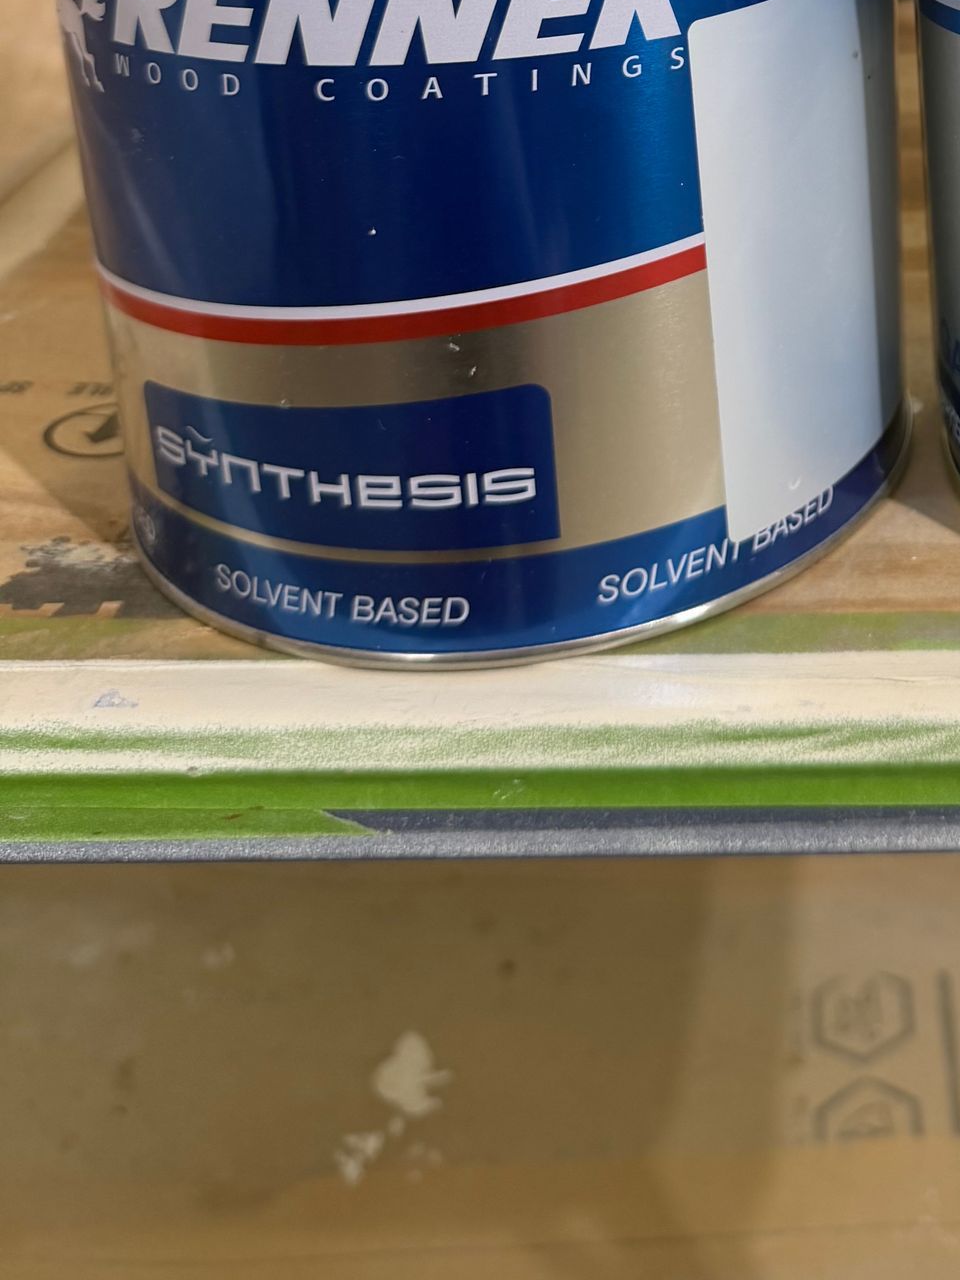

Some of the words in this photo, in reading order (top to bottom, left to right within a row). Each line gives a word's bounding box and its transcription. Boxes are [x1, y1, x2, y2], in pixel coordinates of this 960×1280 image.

[114, 53, 241, 97] WOOD
[316, 47, 686, 102] COATINGS
[752, 486, 834, 552] BASED
[215, 563, 342, 618] SOLVENT
[352, 595, 470, 626] BASED
